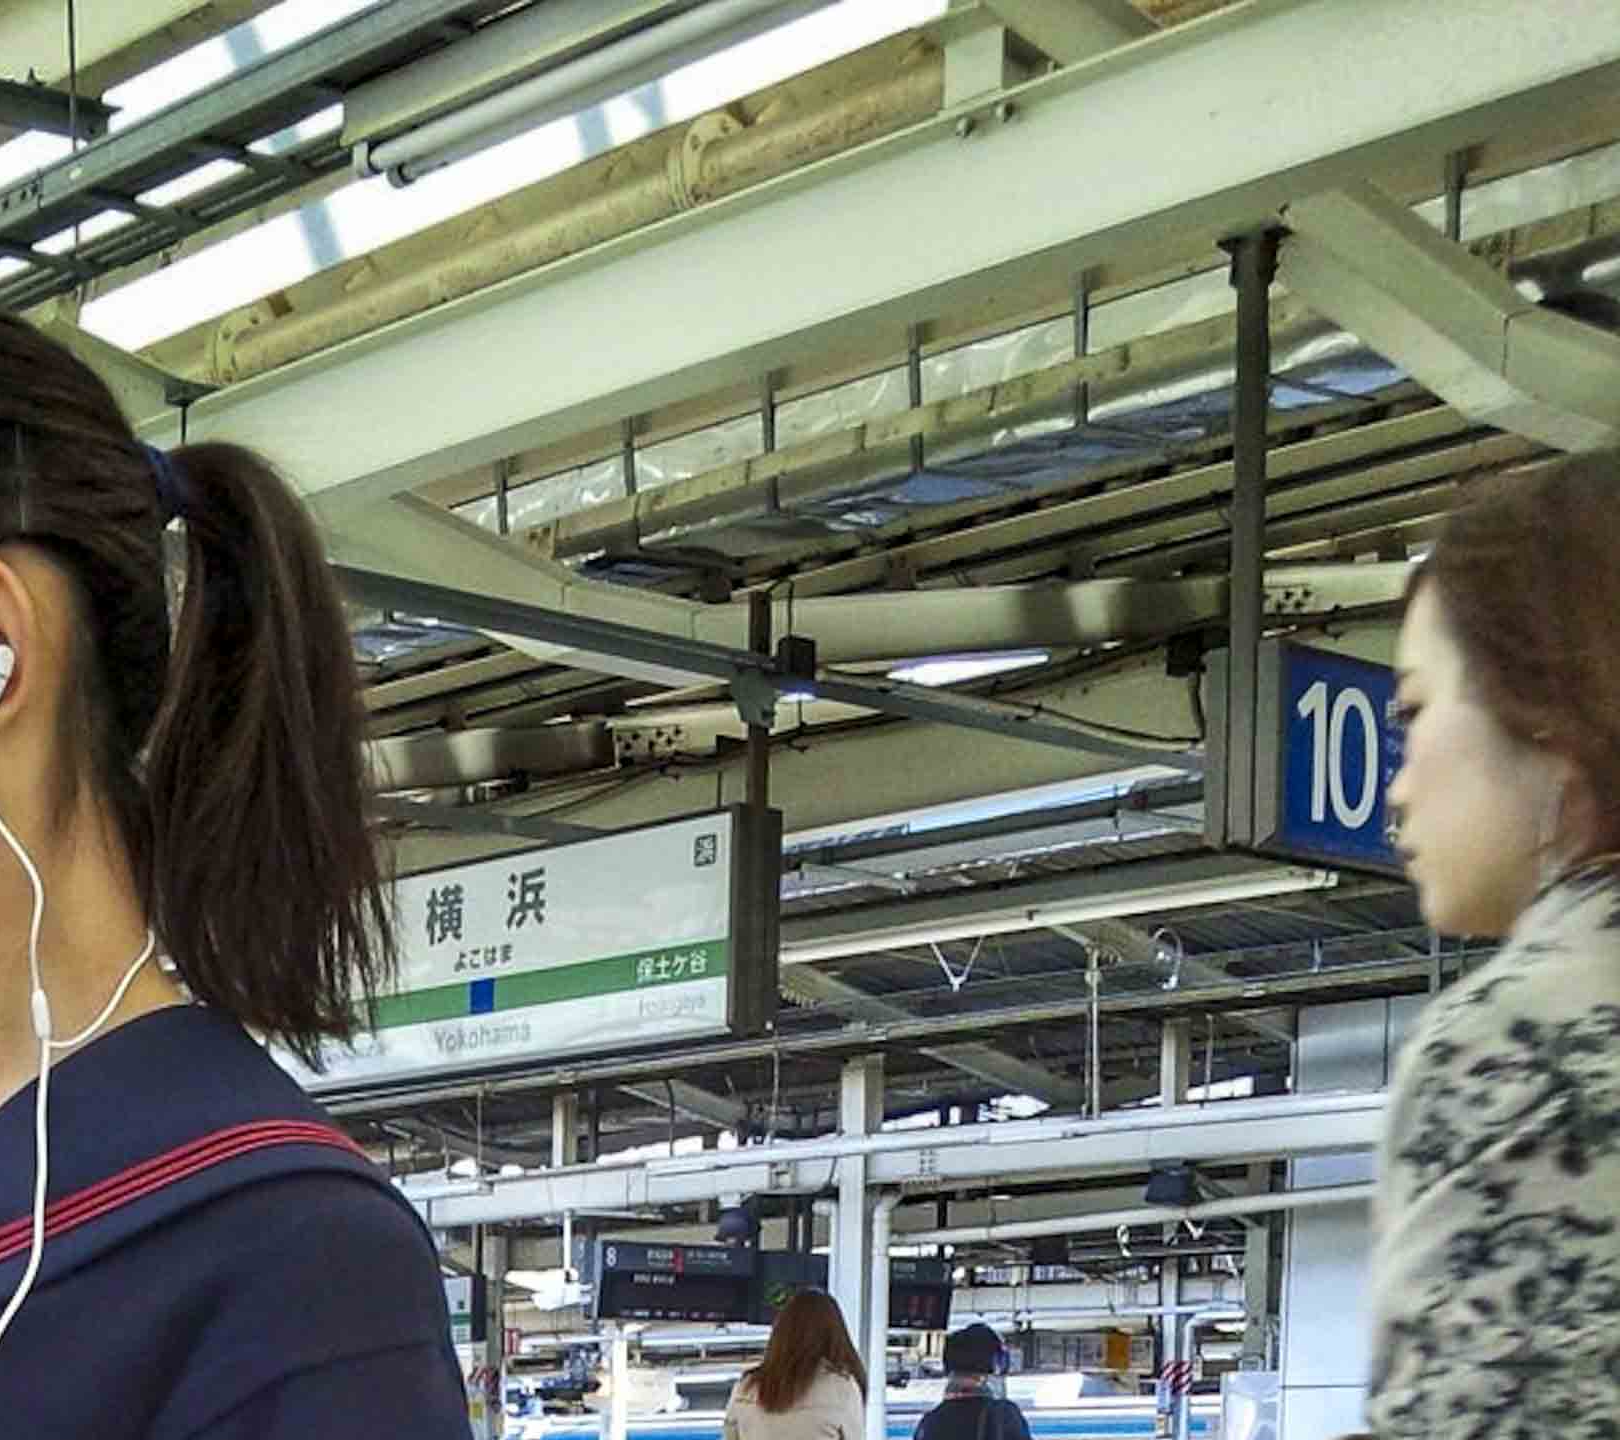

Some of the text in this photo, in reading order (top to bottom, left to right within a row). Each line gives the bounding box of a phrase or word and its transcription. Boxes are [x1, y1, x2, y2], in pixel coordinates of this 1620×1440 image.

[1297, 681, 1378, 830] 10
[426, 867, 546, 946] 横浜
[454, 944, 512, 972] よこはま
[434, 1018, 531, 1054] Yokohama
[606, 1247, 617, 1267] 8
